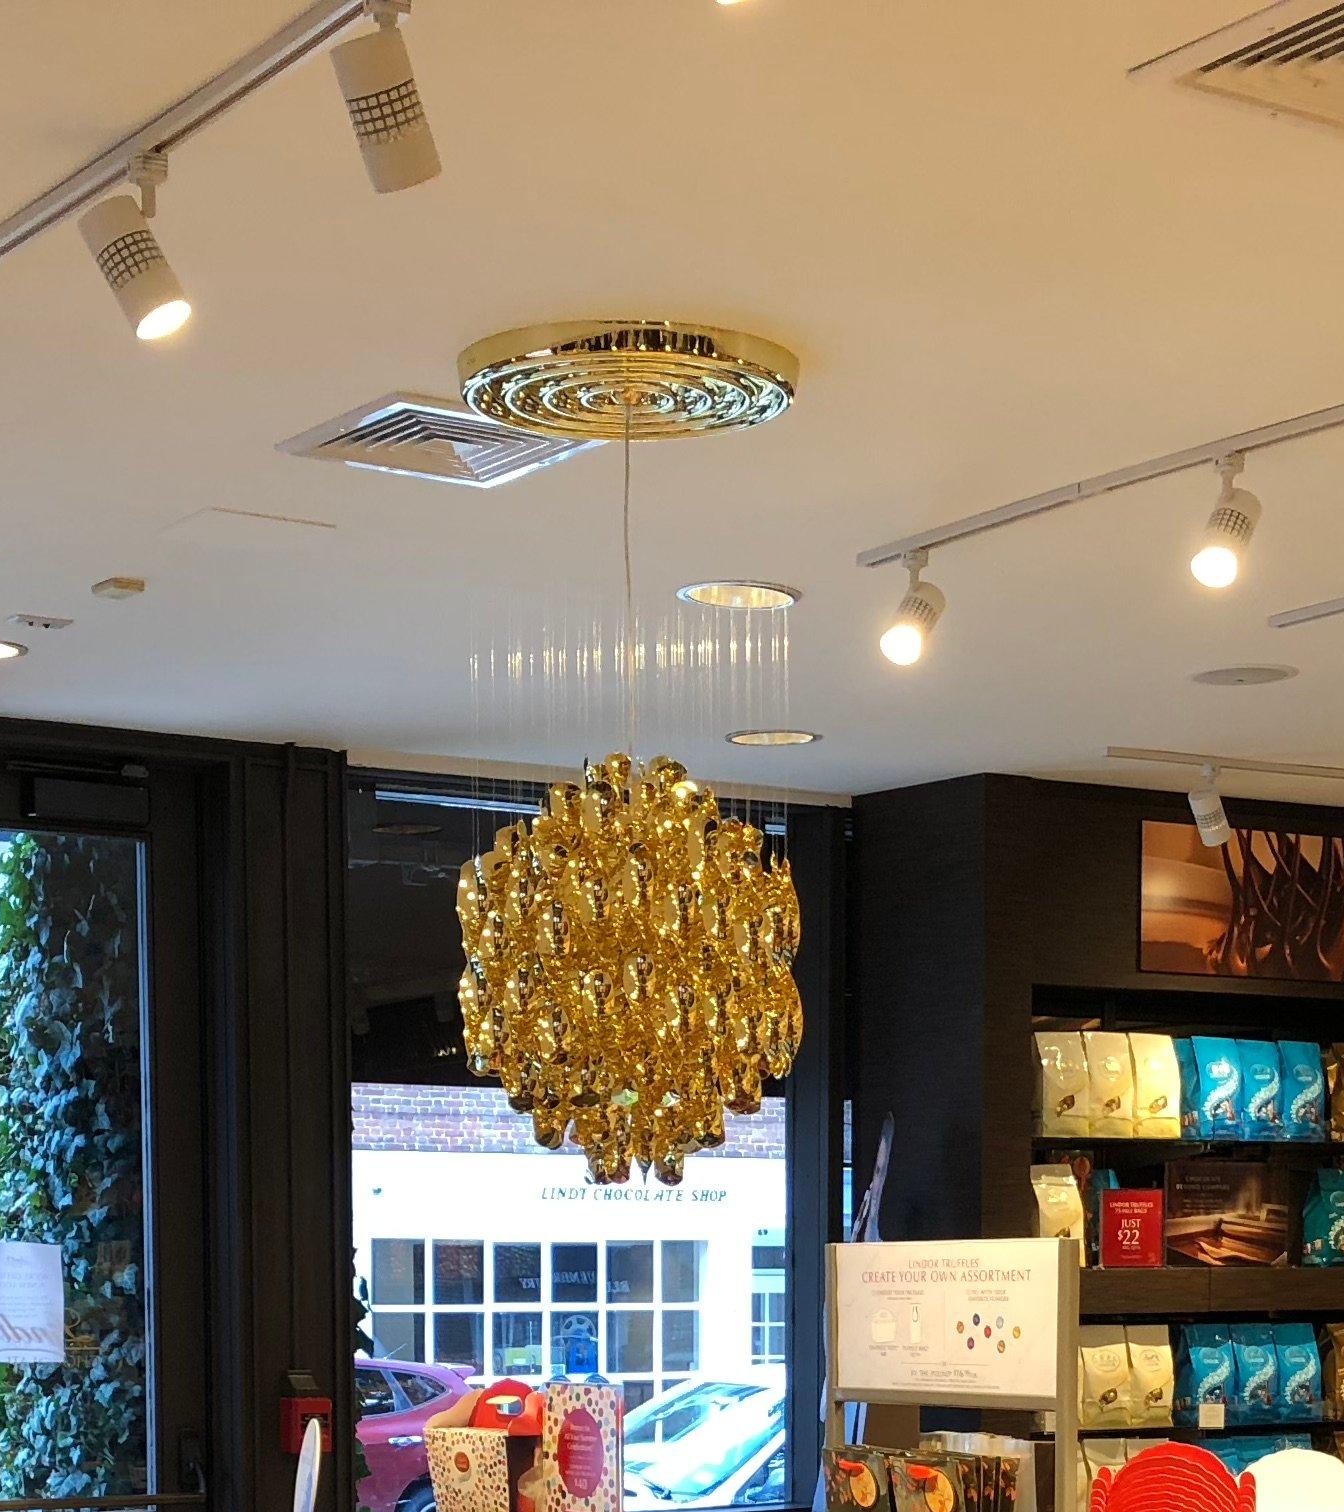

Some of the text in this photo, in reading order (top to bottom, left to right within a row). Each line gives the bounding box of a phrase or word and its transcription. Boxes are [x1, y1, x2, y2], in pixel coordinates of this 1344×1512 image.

[542, 1187, 728, 1202] LINDT CHOCOLATE SHOP
[1121, 1219, 1142, 1229] JUST
[1117, 1229, 1140, 1245] $22
[908, 1258, 980, 1269] LINDOR TRUFFLES
[861, 1269, 1032, 1284] CREATE YOUR OWN ASSORTMENT
